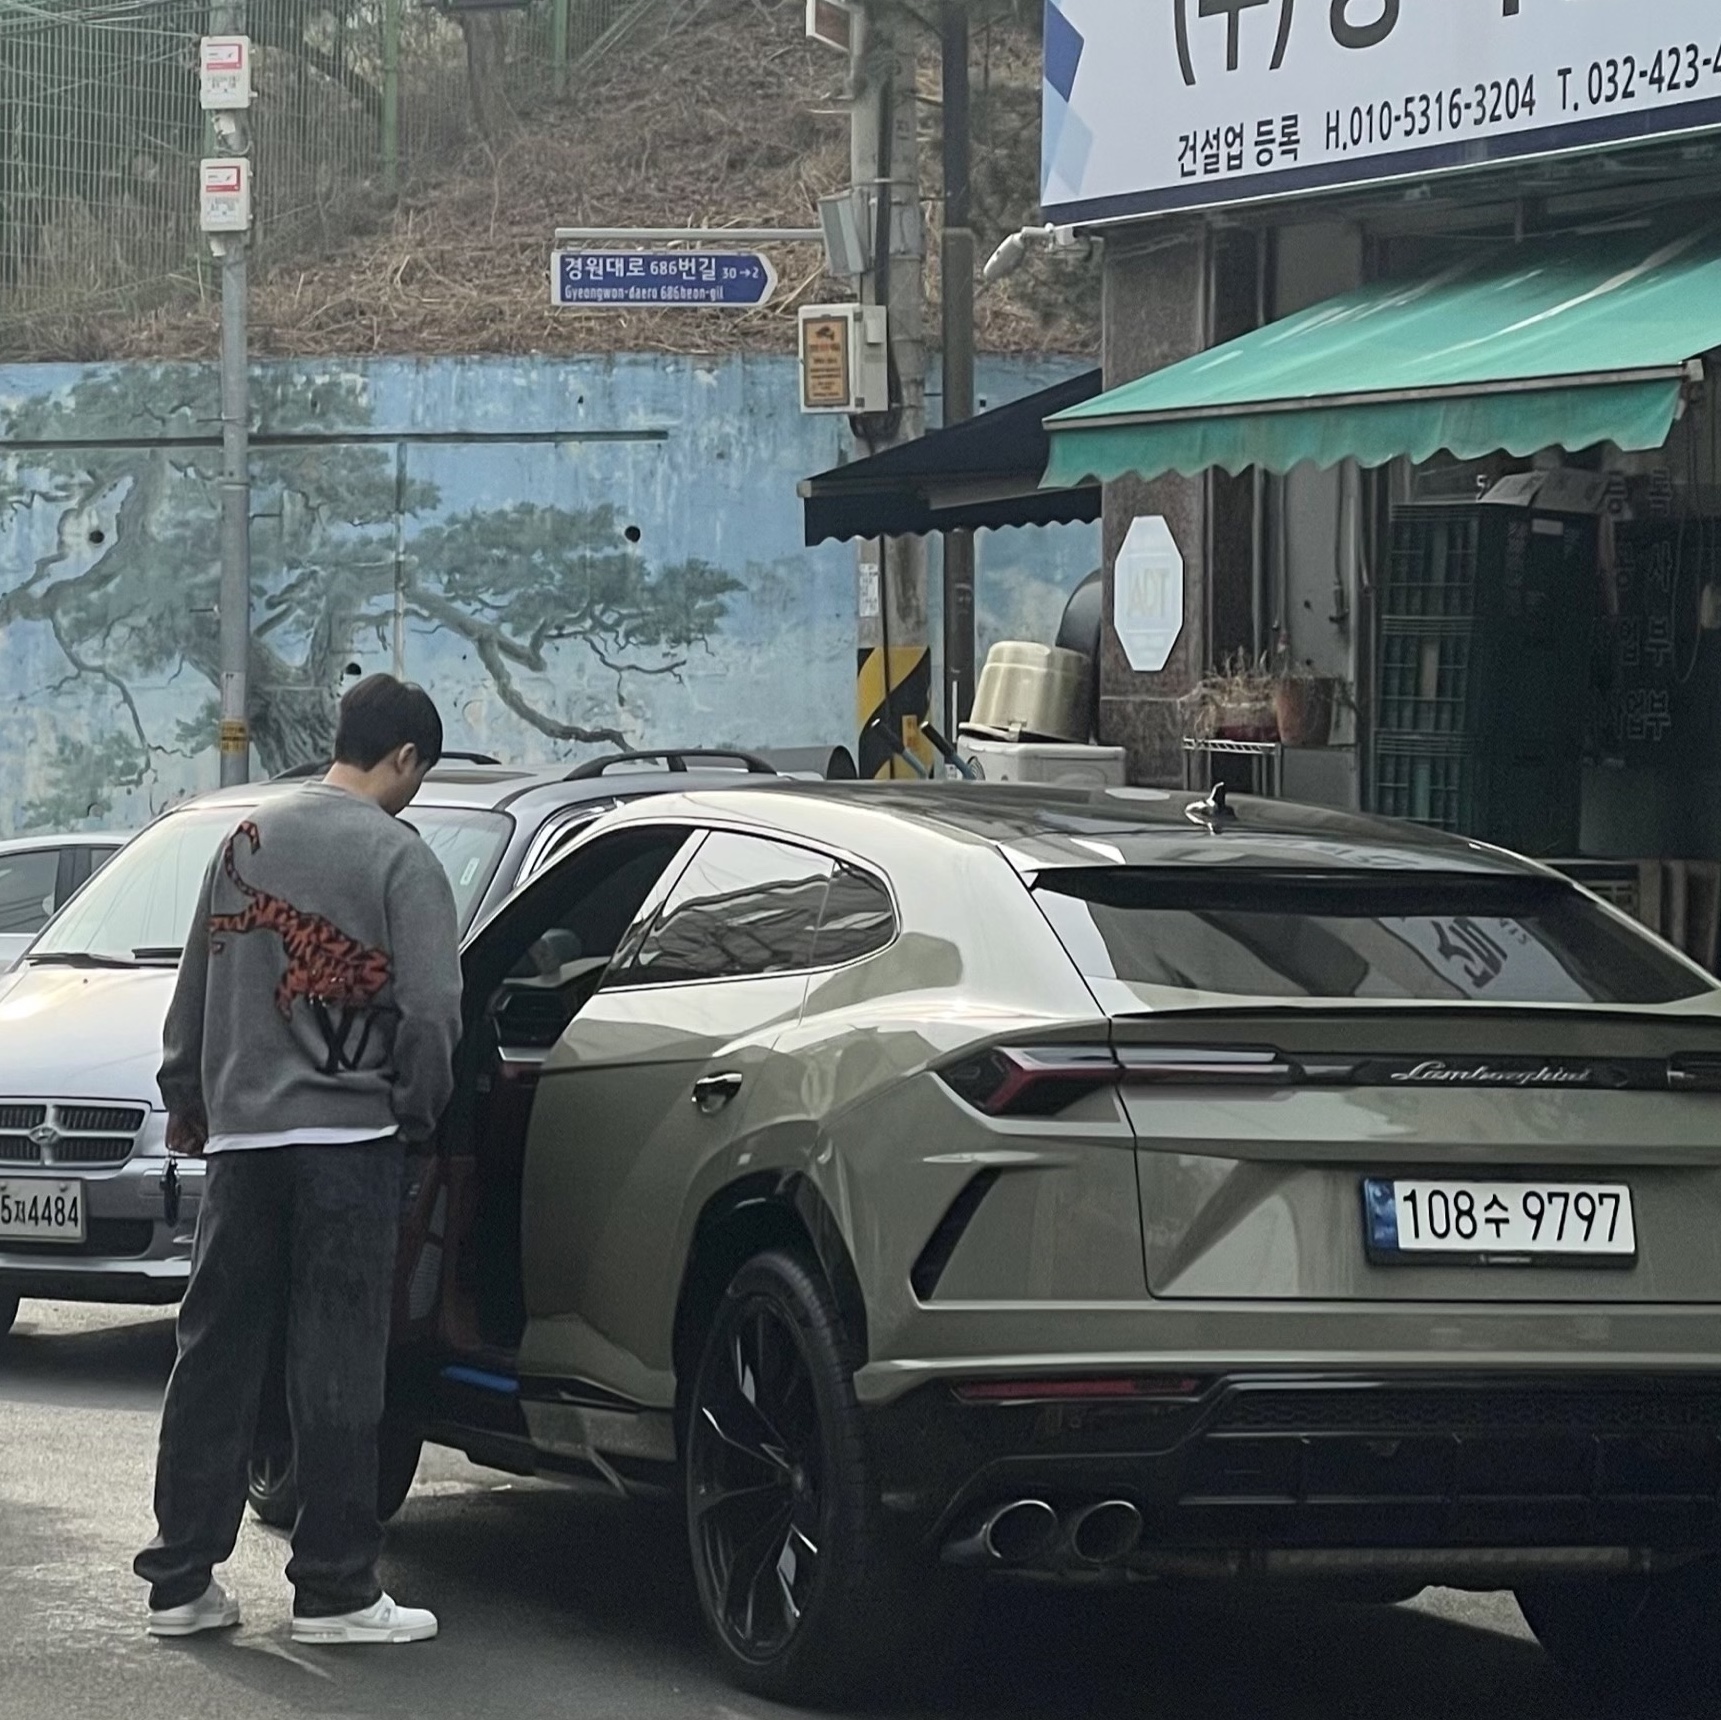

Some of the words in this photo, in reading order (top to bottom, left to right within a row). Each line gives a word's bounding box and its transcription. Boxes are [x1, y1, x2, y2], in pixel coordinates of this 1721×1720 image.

[1178, 122, 1244, 178] 건설업
[1254, 114, 1301, 167] 등록
[1325, 74, 1535, 151] H.010-5316-3204
[565, 257, 646, 281] 경원대로
[650, 257, 716, 281] 686번길
[722, 267, 737, 279] 30
[564, 285, 658, 302] Gyeongwon-daero
[660, 285, 724, 302] 686beon-gil
[1391, 1060, 1592, 1085] Lamborghini
[1522, 1190, 1621, 1243] 9797
